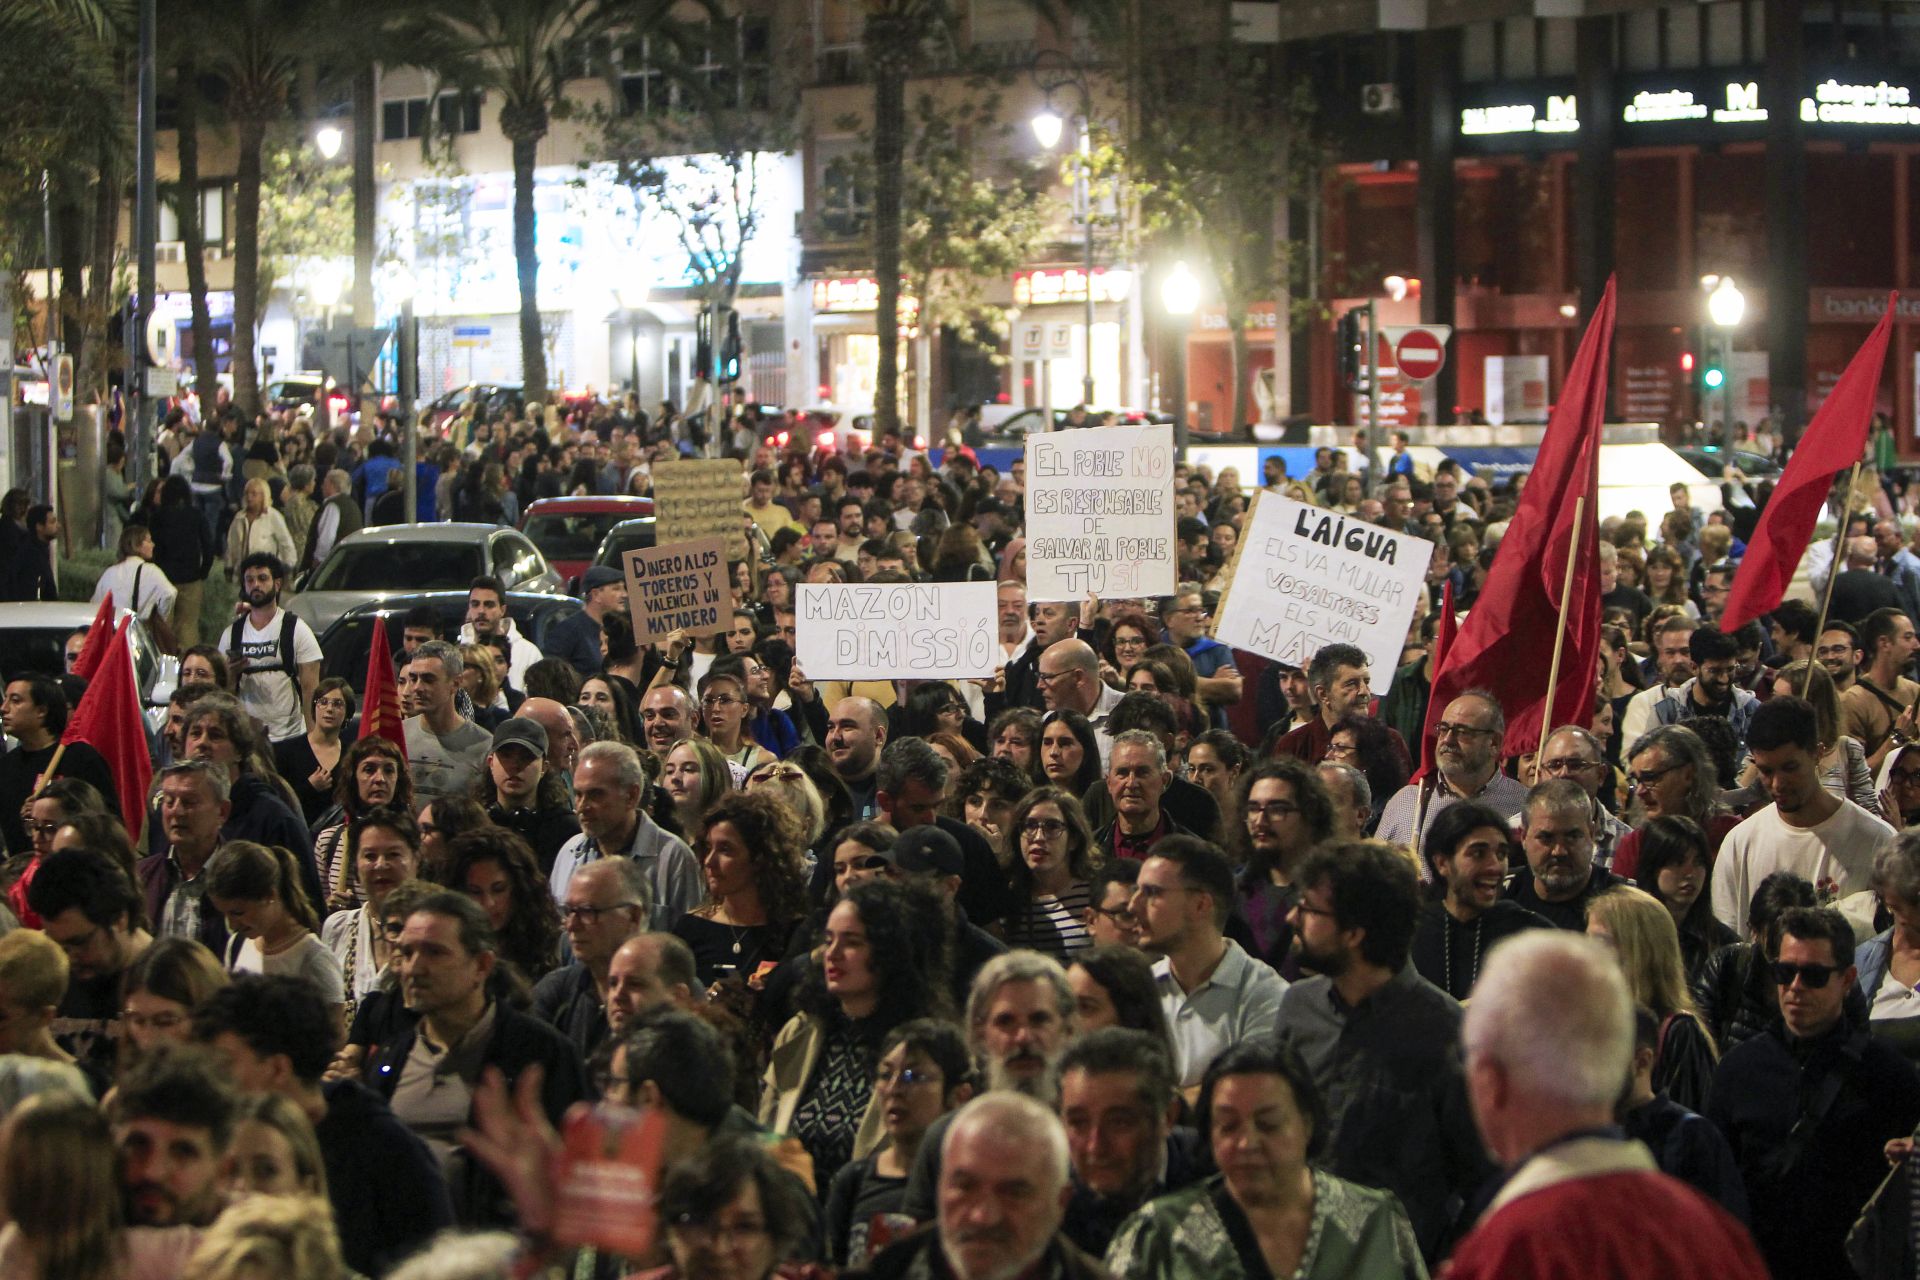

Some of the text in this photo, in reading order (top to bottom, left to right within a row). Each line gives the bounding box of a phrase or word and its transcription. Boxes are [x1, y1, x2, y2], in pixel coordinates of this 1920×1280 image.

[1034, 443, 1167, 478] EL POBLE NO
[1034, 488, 1163, 515] ES RESPONSABLE
[1083, 517, 1107, 534] DE
[632, 556, 682, 578] DINERO
[694, 551, 718, 569] LOS
[1032, 537, 1172, 564] SALVAR AL POBLE,
[639, 571, 712, 597] TOREROS Y
[1055, 559, 1144, 593] TU SÍ
[1264, 537, 1405, 606] ELS VA MULLAR
[644, 589, 720, 613] VALENCIA UN
[805, 584, 941, 621] MAZÓN
[1266, 568, 1380, 625] VOSALTRES
[647, 607, 717, 634] MATADERO
[1284, 602, 1361, 642] ELS VAU
[836, 617, 990, 669] DIMISSIÓ
